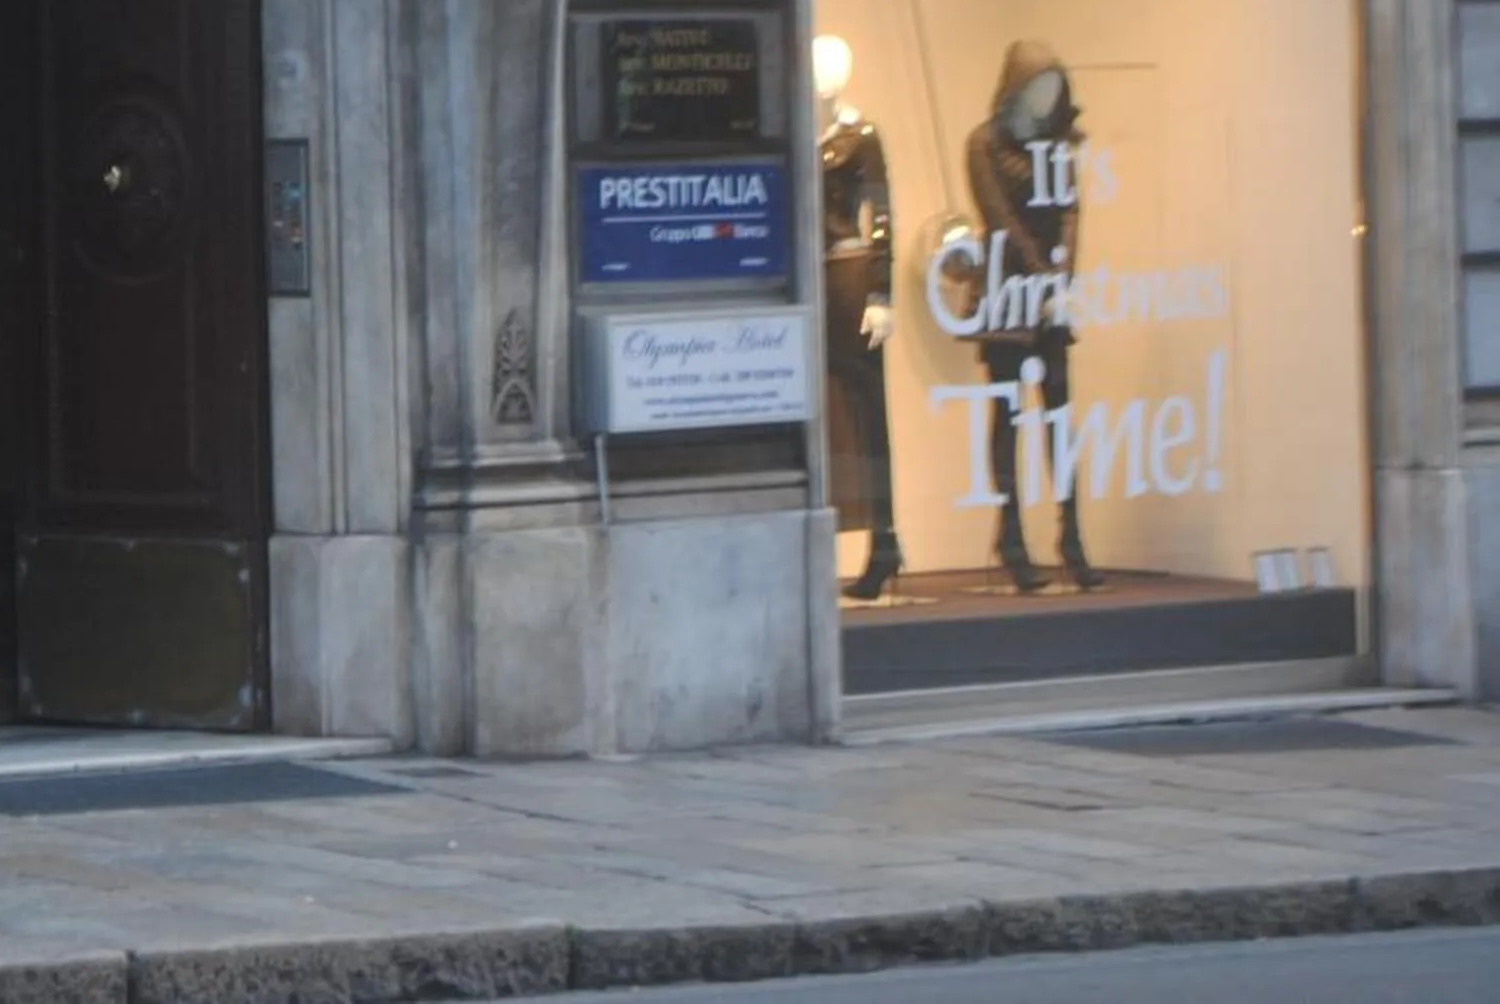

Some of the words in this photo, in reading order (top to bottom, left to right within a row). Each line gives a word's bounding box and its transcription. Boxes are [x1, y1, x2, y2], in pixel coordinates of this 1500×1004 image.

[599, 174, 768, 210] PRESTITALIA
[1023, 139, 1121, 207] It's
[927, 229, 1231, 337] Christmas
[927, 349, 1228, 509] Time!
